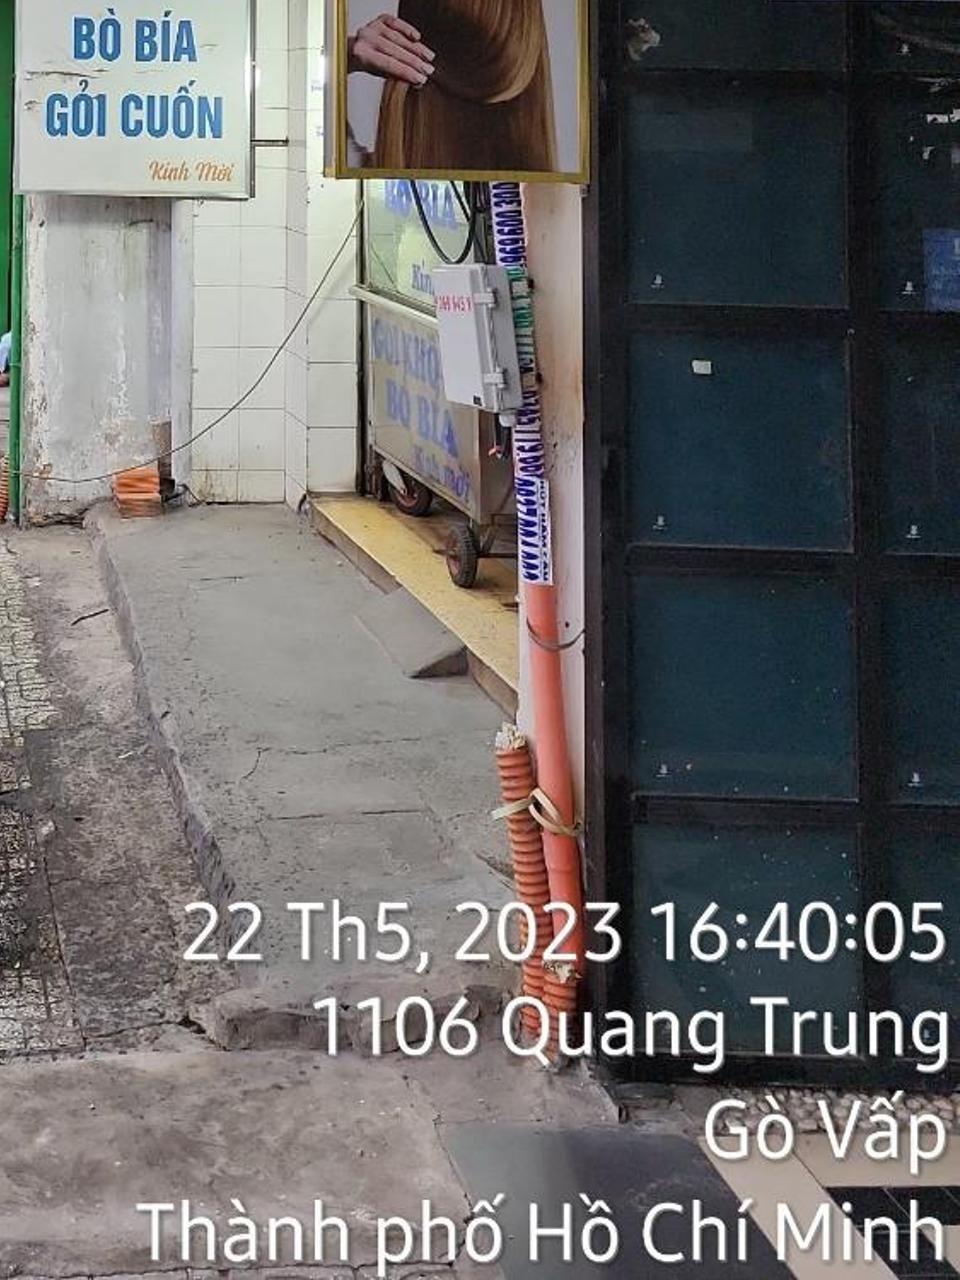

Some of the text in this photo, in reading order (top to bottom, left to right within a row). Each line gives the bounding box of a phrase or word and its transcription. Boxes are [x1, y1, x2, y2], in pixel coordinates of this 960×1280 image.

[73, 7, 198, 62] BÒ BÍA
[120, 80, 224, 139] CUỐN
